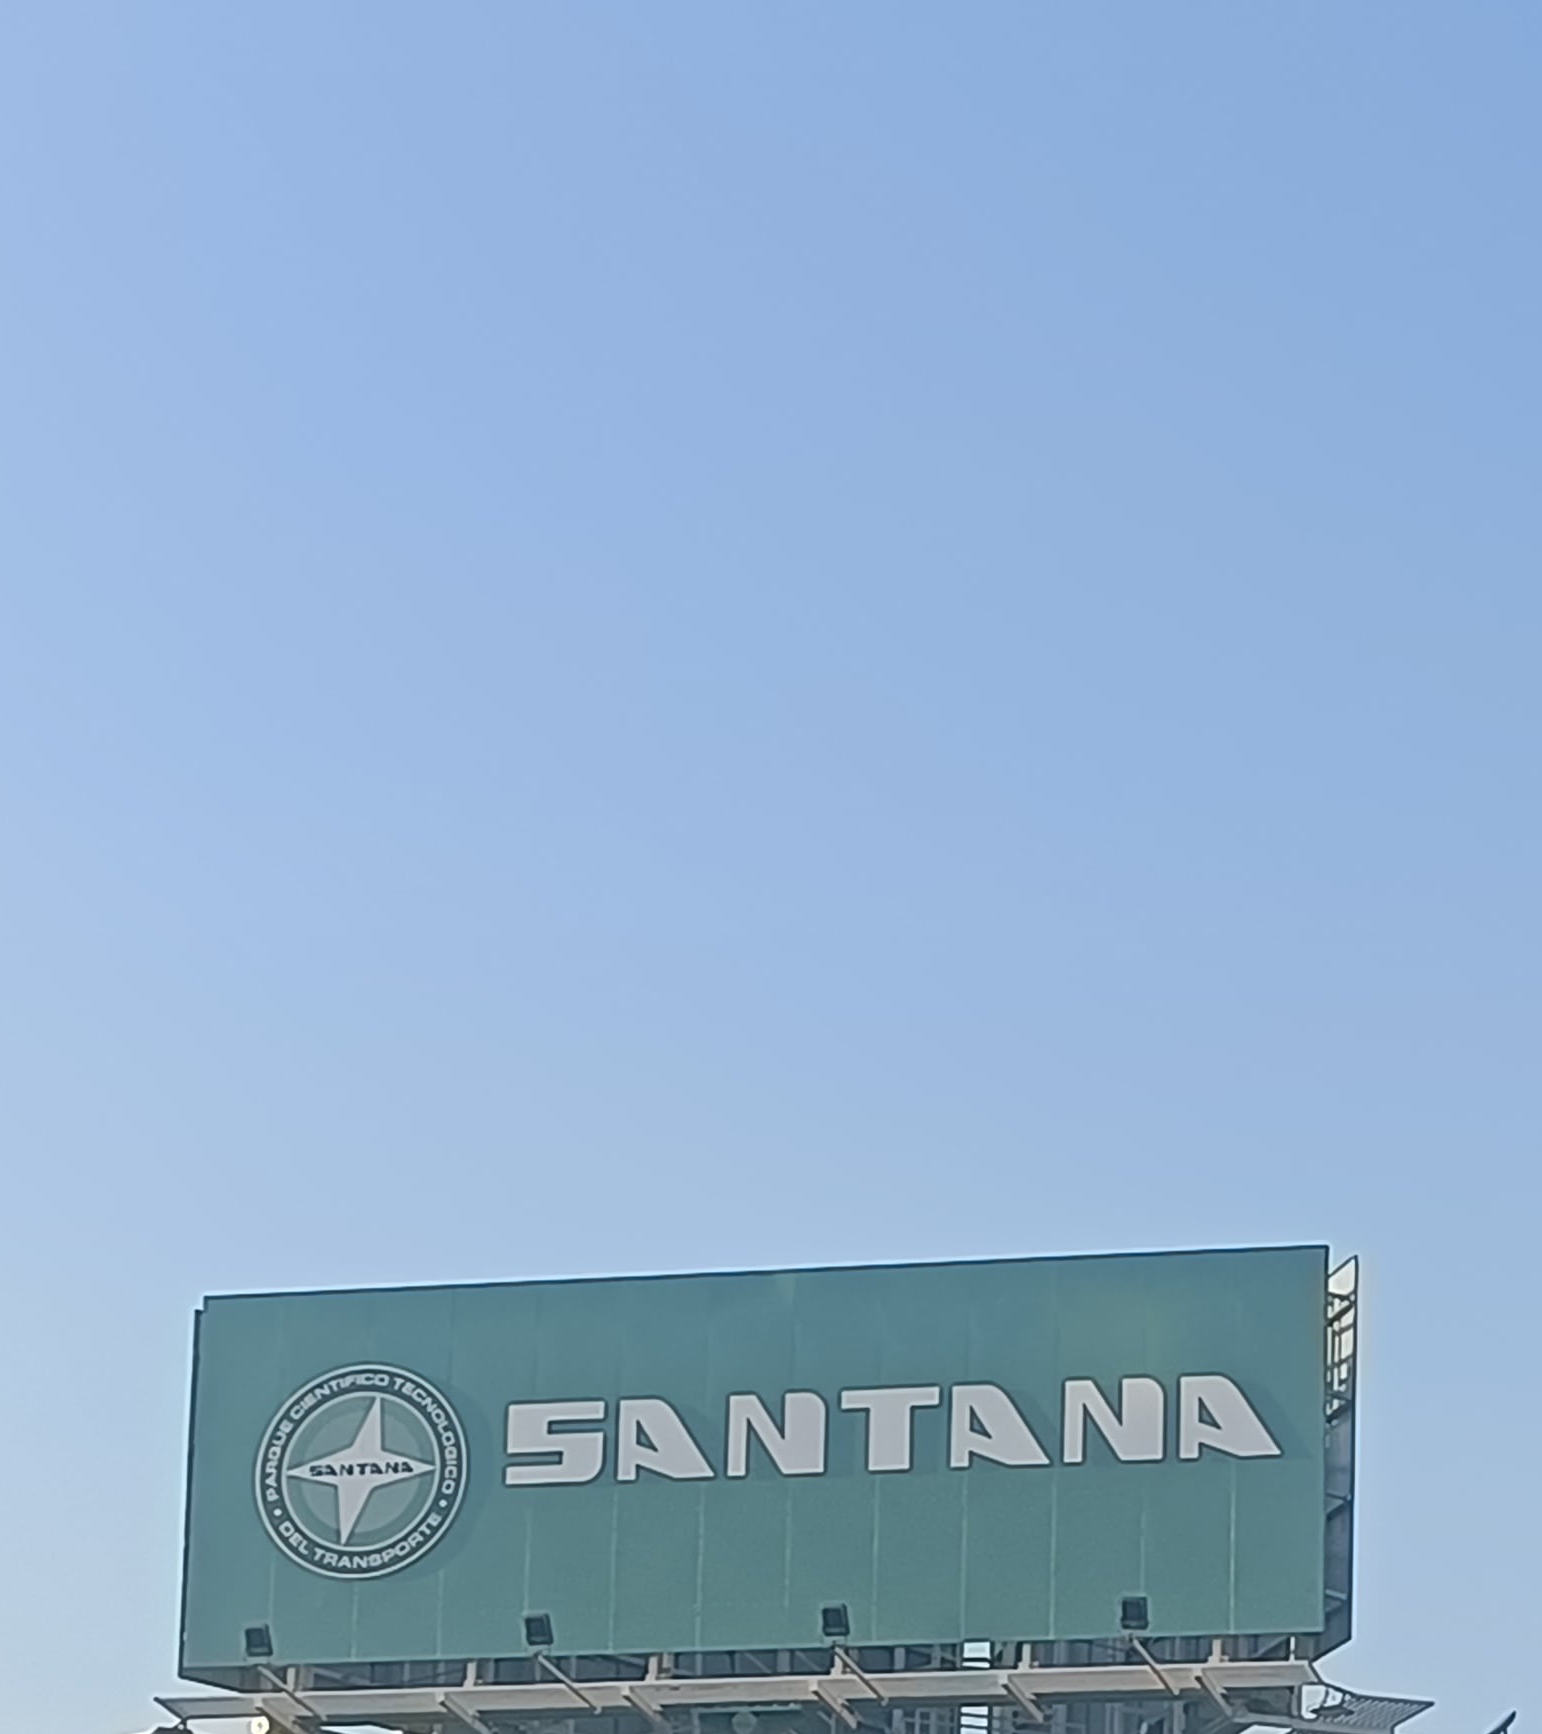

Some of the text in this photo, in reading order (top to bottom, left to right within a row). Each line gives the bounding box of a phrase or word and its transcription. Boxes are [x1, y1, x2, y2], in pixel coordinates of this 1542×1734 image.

[264, 1373, 458, 1501] PARQUE CIENTIFICO TECNOLOGICO
[309, 1461, 414, 1477] SANTANA
[504, 1374, 1282, 1486] SANTANA
[278, 1512, 443, 1569] DEL TRANSPORTE
